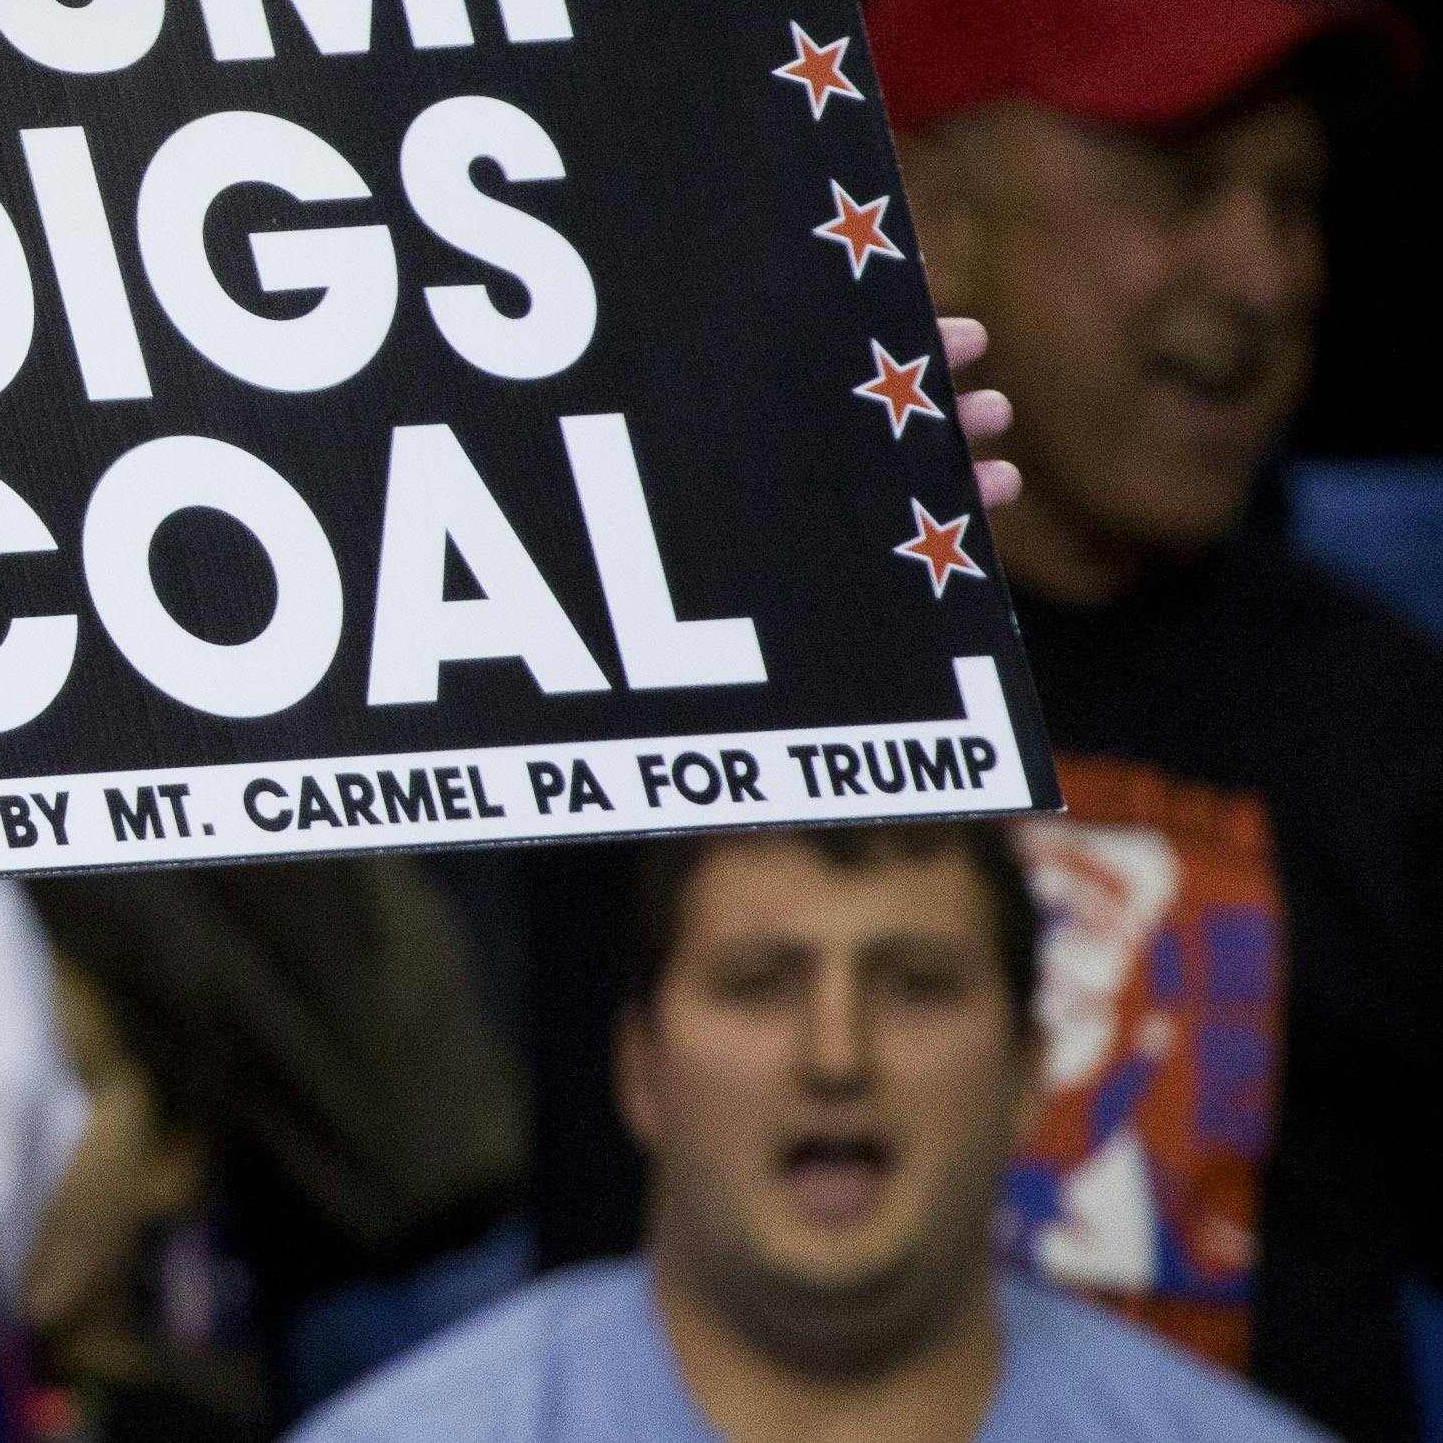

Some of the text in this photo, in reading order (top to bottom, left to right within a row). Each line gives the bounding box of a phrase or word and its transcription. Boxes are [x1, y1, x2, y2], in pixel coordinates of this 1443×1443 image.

[102, 783, 215, 843] MT.
[242, 764, 505, 834] CARMEL
[527, 758, 615, 816] PA
[636, 748, 766, 809] FOR
[789, 735, 1000, 800] TRUMP
